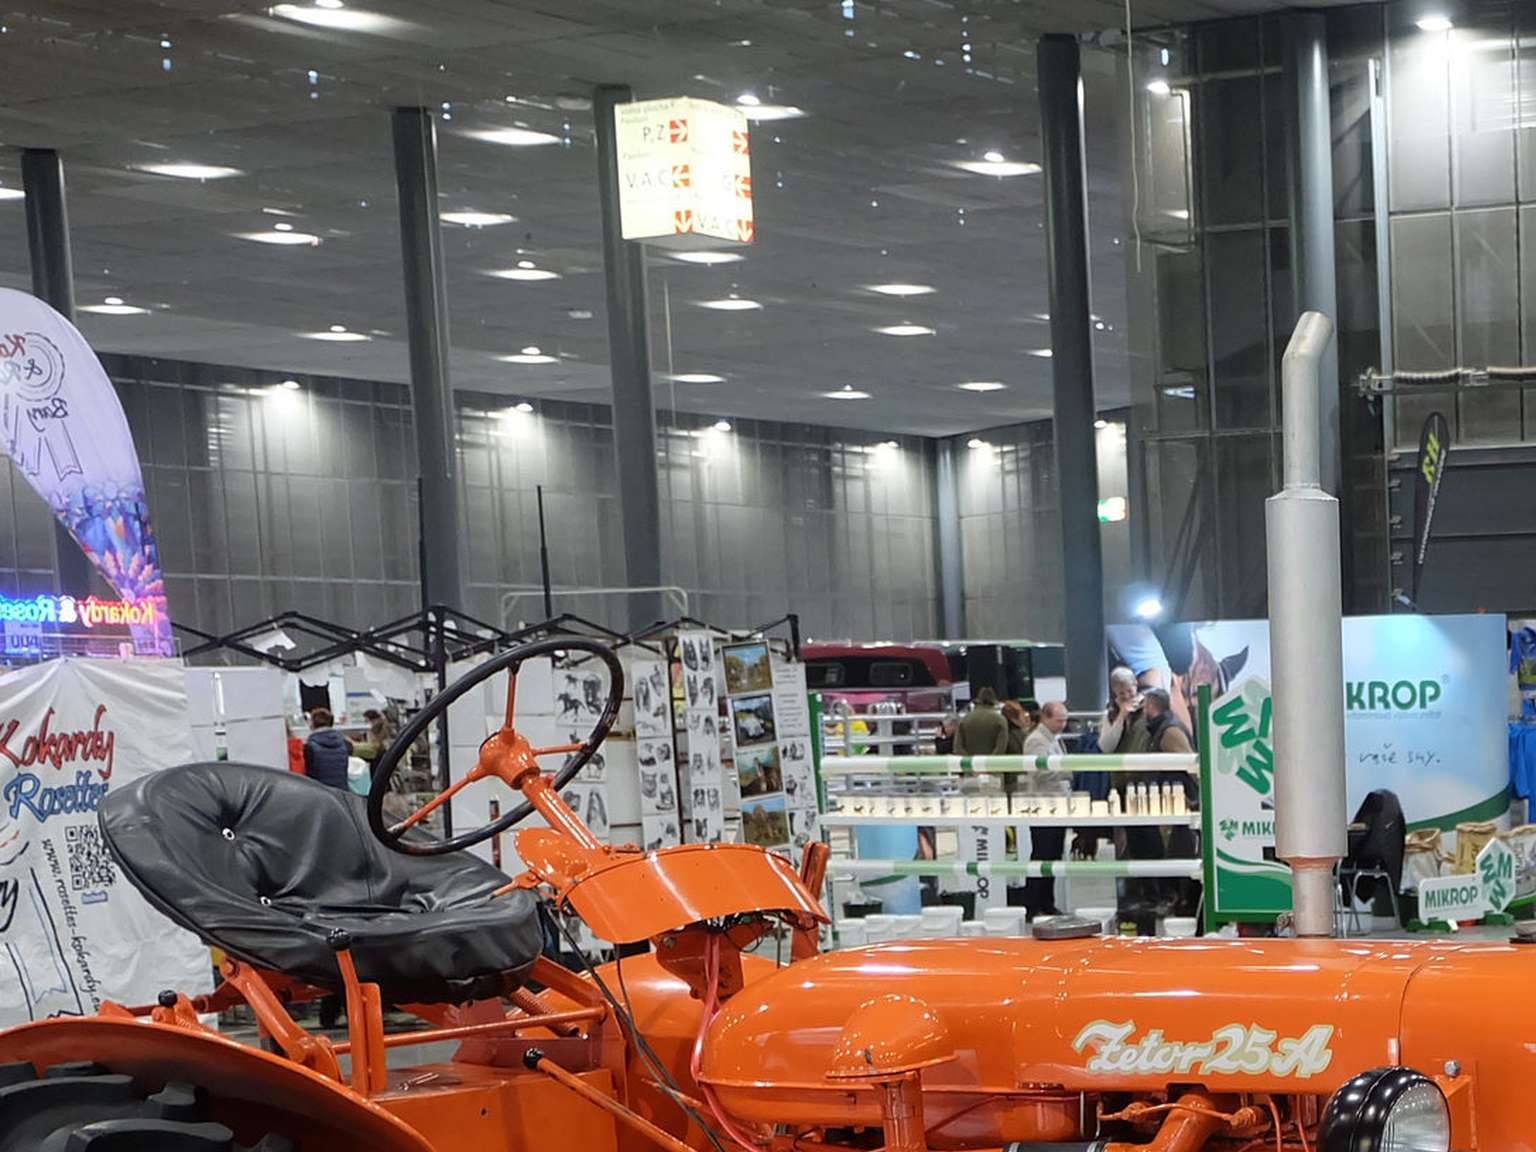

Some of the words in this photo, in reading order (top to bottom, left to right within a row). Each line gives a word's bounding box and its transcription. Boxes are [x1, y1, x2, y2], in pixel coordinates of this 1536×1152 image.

[0, 704, 115, 781] Kokardy
[1242, 820, 1276, 837] MIK
[976, 838, 989, 899] MIOP
[1425, 886, 1479, 909] MIKROP
[1071, 1018, 1217, 1076] Zetor
